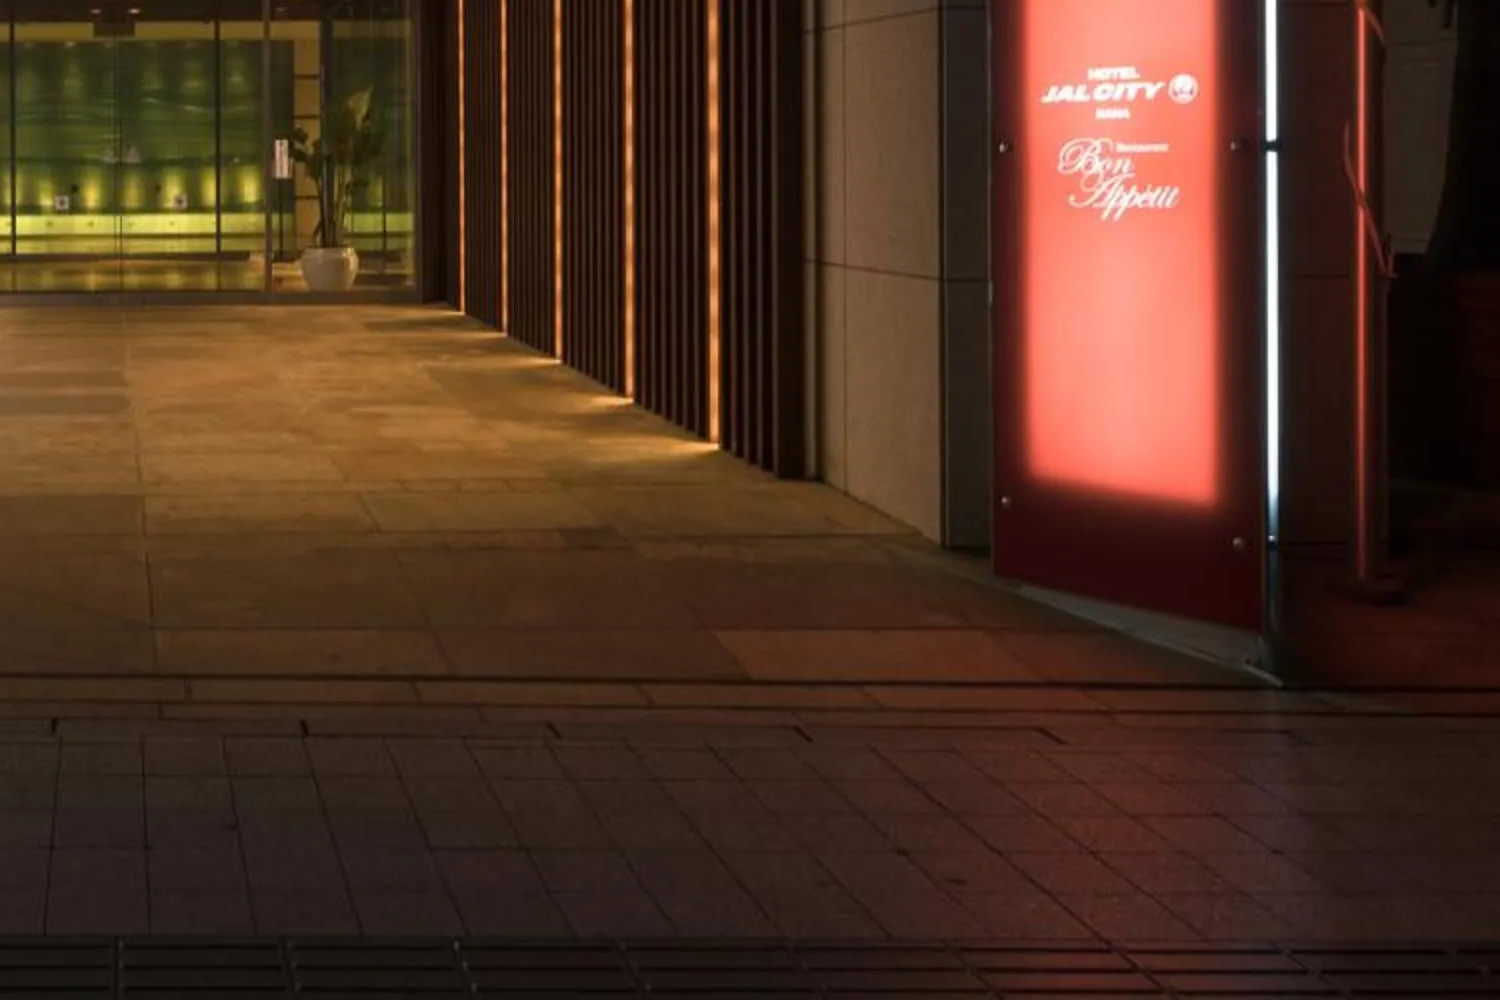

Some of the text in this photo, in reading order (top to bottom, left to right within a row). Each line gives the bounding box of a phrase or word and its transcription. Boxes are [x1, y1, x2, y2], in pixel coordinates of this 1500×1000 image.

[1087, 66, 1140, 81] HOTEL
[1041, 81, 1167, 104] JAL CITY
[1057, 137, 1135, 175] Bon
